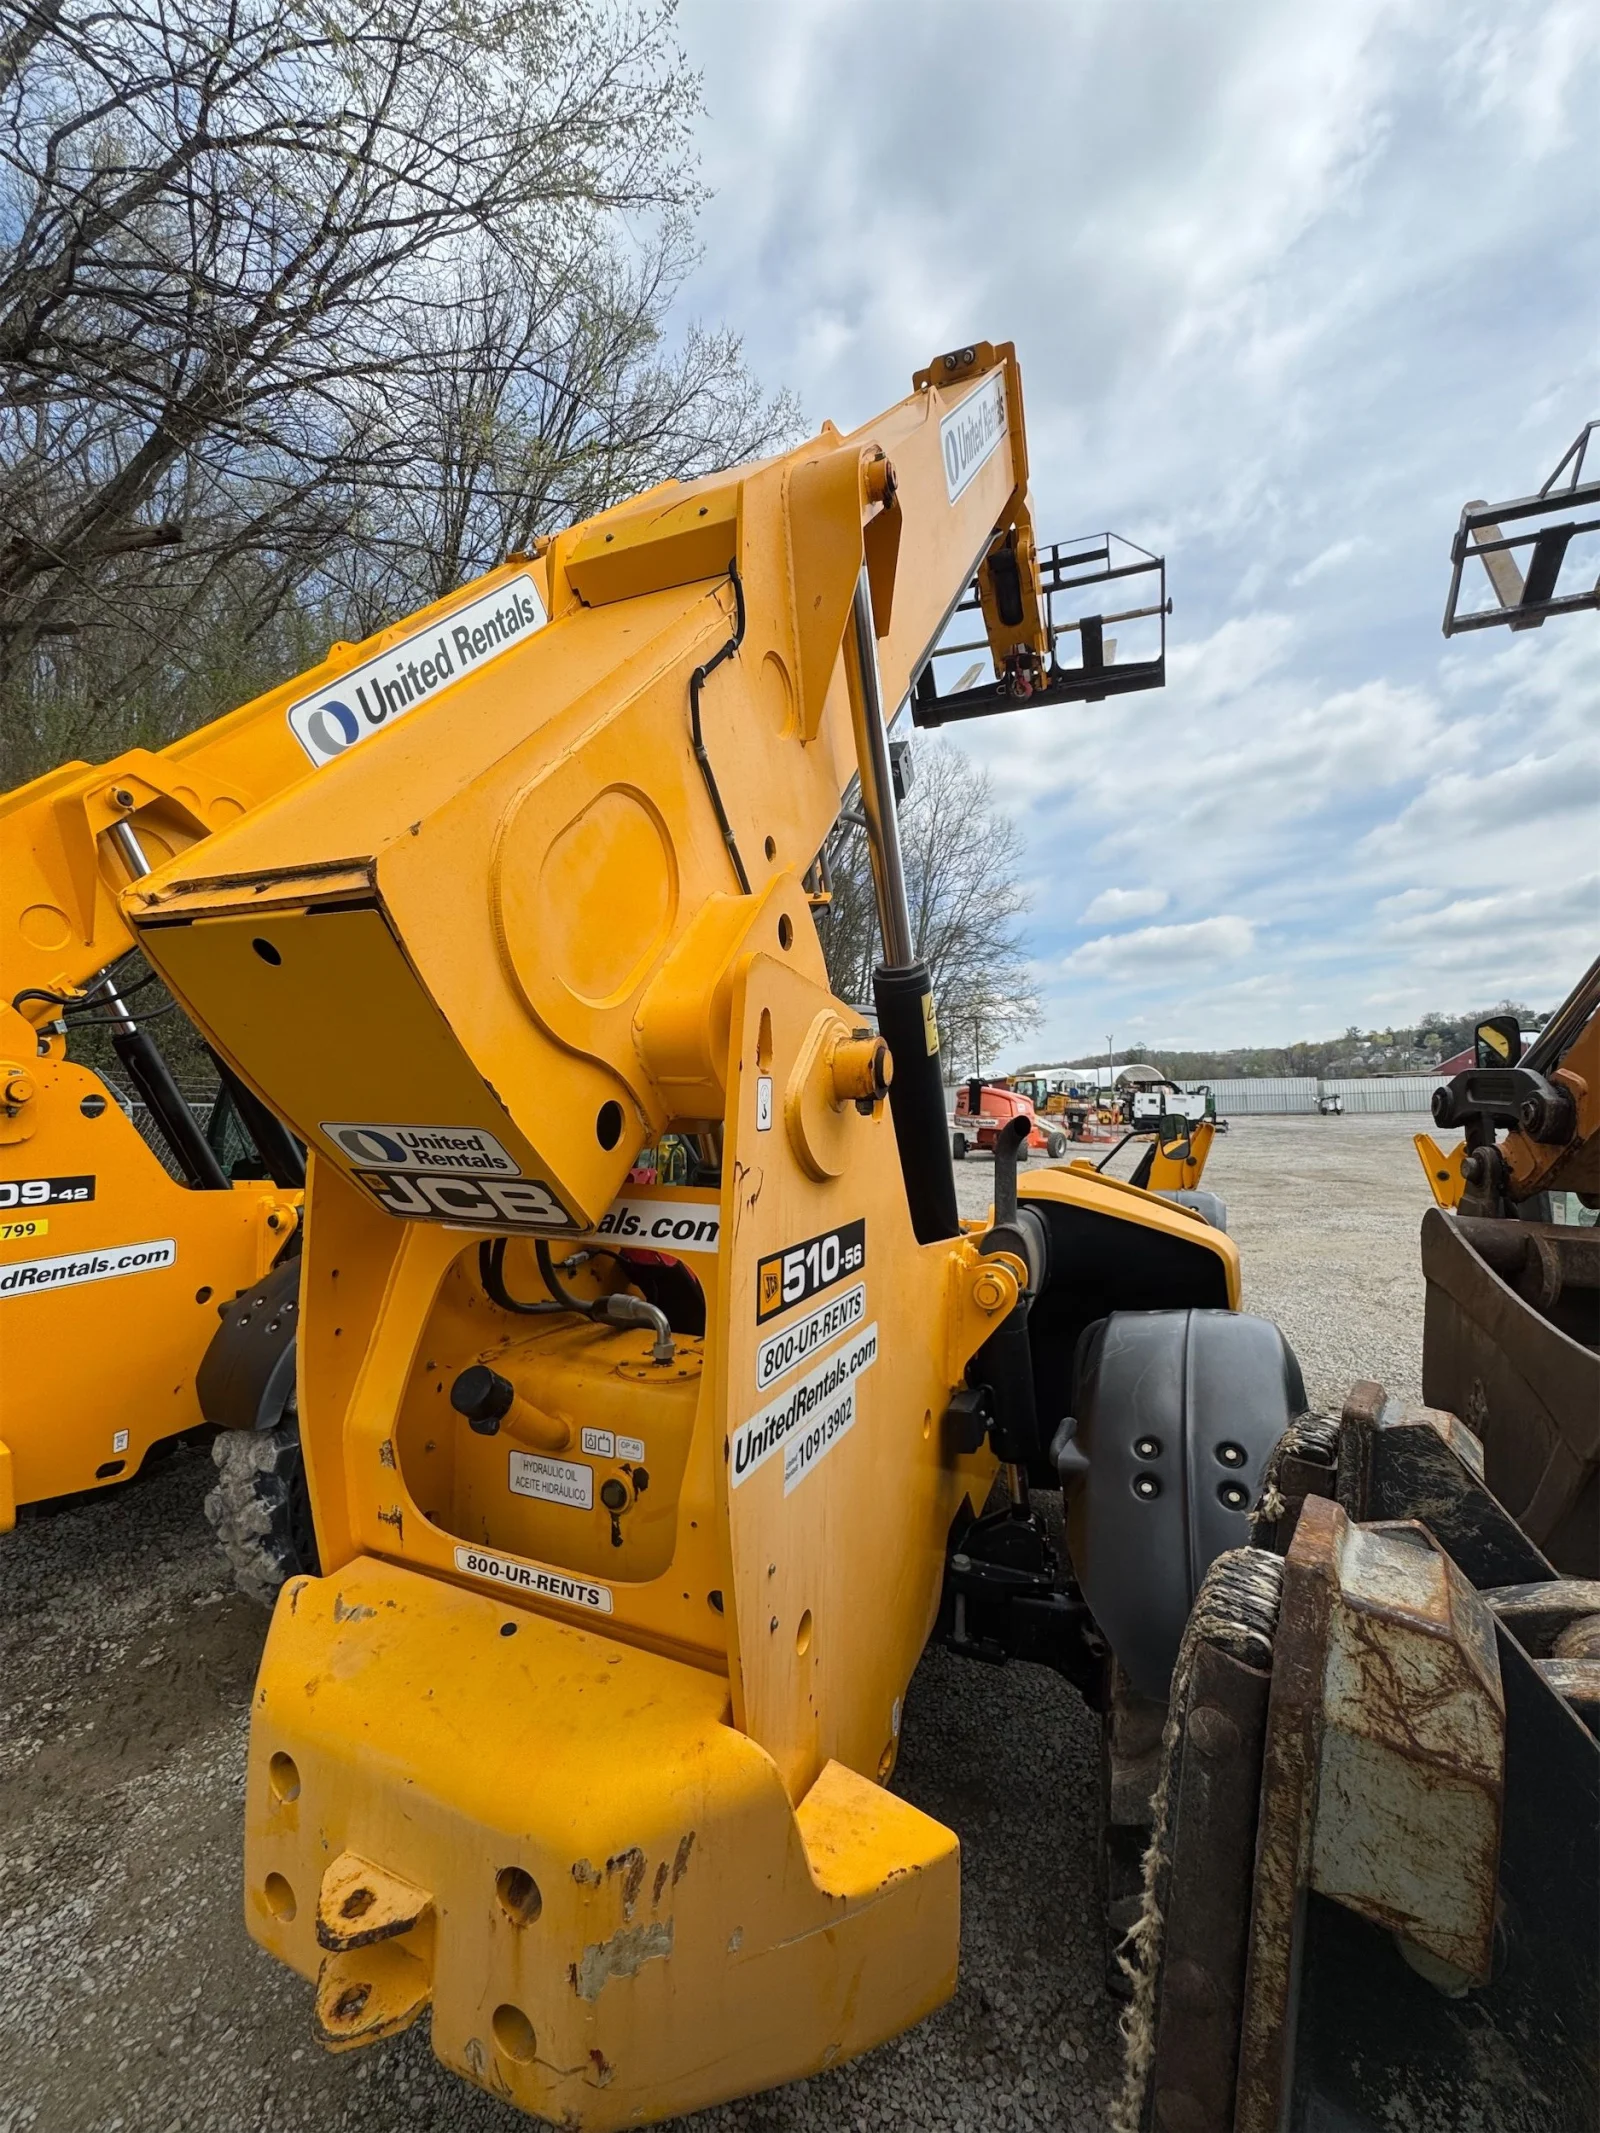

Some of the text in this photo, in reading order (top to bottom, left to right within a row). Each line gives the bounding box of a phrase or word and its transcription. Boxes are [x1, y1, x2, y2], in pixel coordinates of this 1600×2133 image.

[958, 405, 984, 470] United
[356, 594, 535, 725] United Rentals
[395, 1132, 486, 1153] United
[411, 1149, 508, 1170] Rentals
[378, 1175, 568, 1224] JCB
[1, 1222, 36, 1239] 799
[0, 1249, 169, 1290] dRentals.com
[763, 1291, 862, 1378] 800-UR-RENTS
[735, 1335, 876, 1475] UnitedRentals.com
[798, 1396, 852, 1468] 10913902
[515, 1475, 541, 1491] ACEITE
[523, 1460, 578, 1482] HYDRAULIC OIL
[466, 1555, 600, 1606] 800-UR-RENTS
